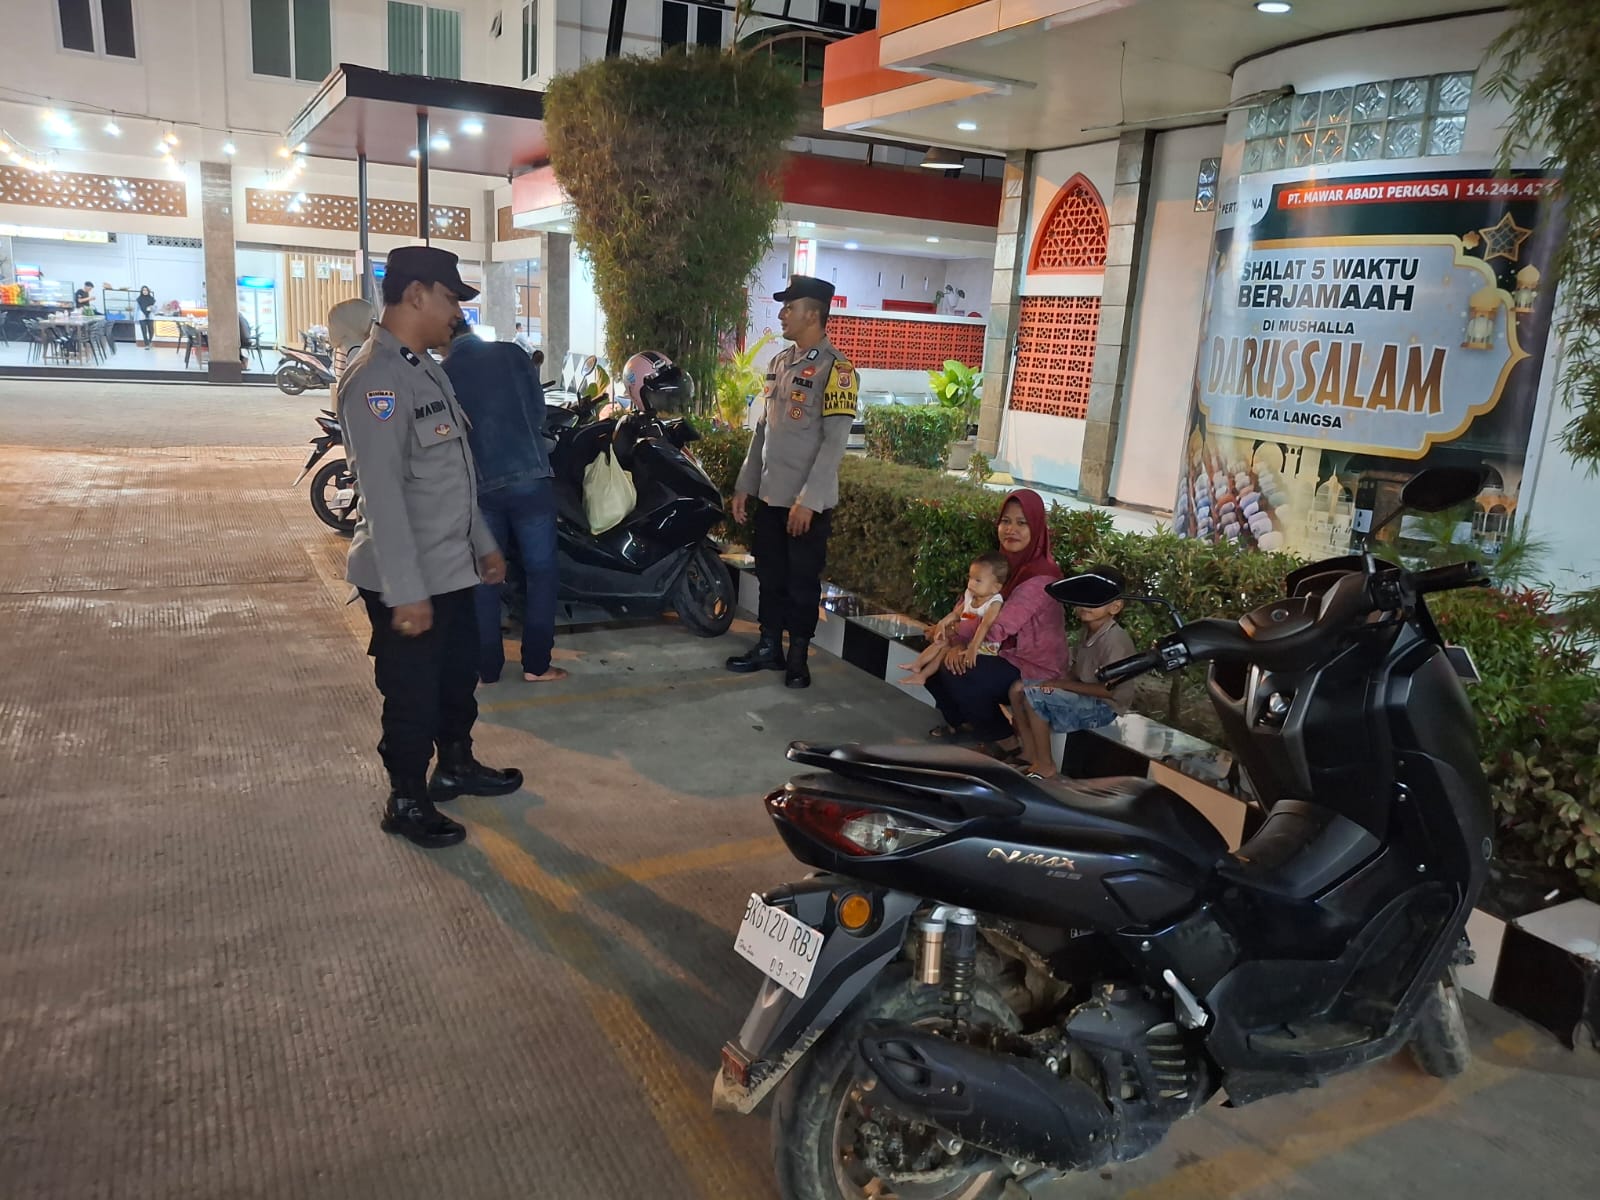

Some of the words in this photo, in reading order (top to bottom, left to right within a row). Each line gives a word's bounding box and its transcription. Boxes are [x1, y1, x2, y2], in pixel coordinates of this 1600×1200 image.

[1220, 198, 1263, 214] PERTNA
[1287, 193, 1301, 206] PT.
[1303, 189, 1343, 204] MAWAR
[1345, 187, 1384, 200] ABADI
[1386, 184, 1449, 199] PERKASA
[1241, 260, 1306, 281] SHALAT
[1311, 260, 1326, 280] 5
[1333, 258, 1419, 280] WAKTU
[1237, 284, 1415, 311] BERJAMAAH
[1262, 320, 1275, 332] DI
[1278, 320, 1355, 335] MUSHALLA
[1207, 336, 1447, 415] DARUSSALAM
[1250, 407, 1280, 422] KOTA
[1283, 412, 1343, 429] LANGSA
[987, 847, 1076, 872] NMAX
[789, 926, 820, 963] RBJ
